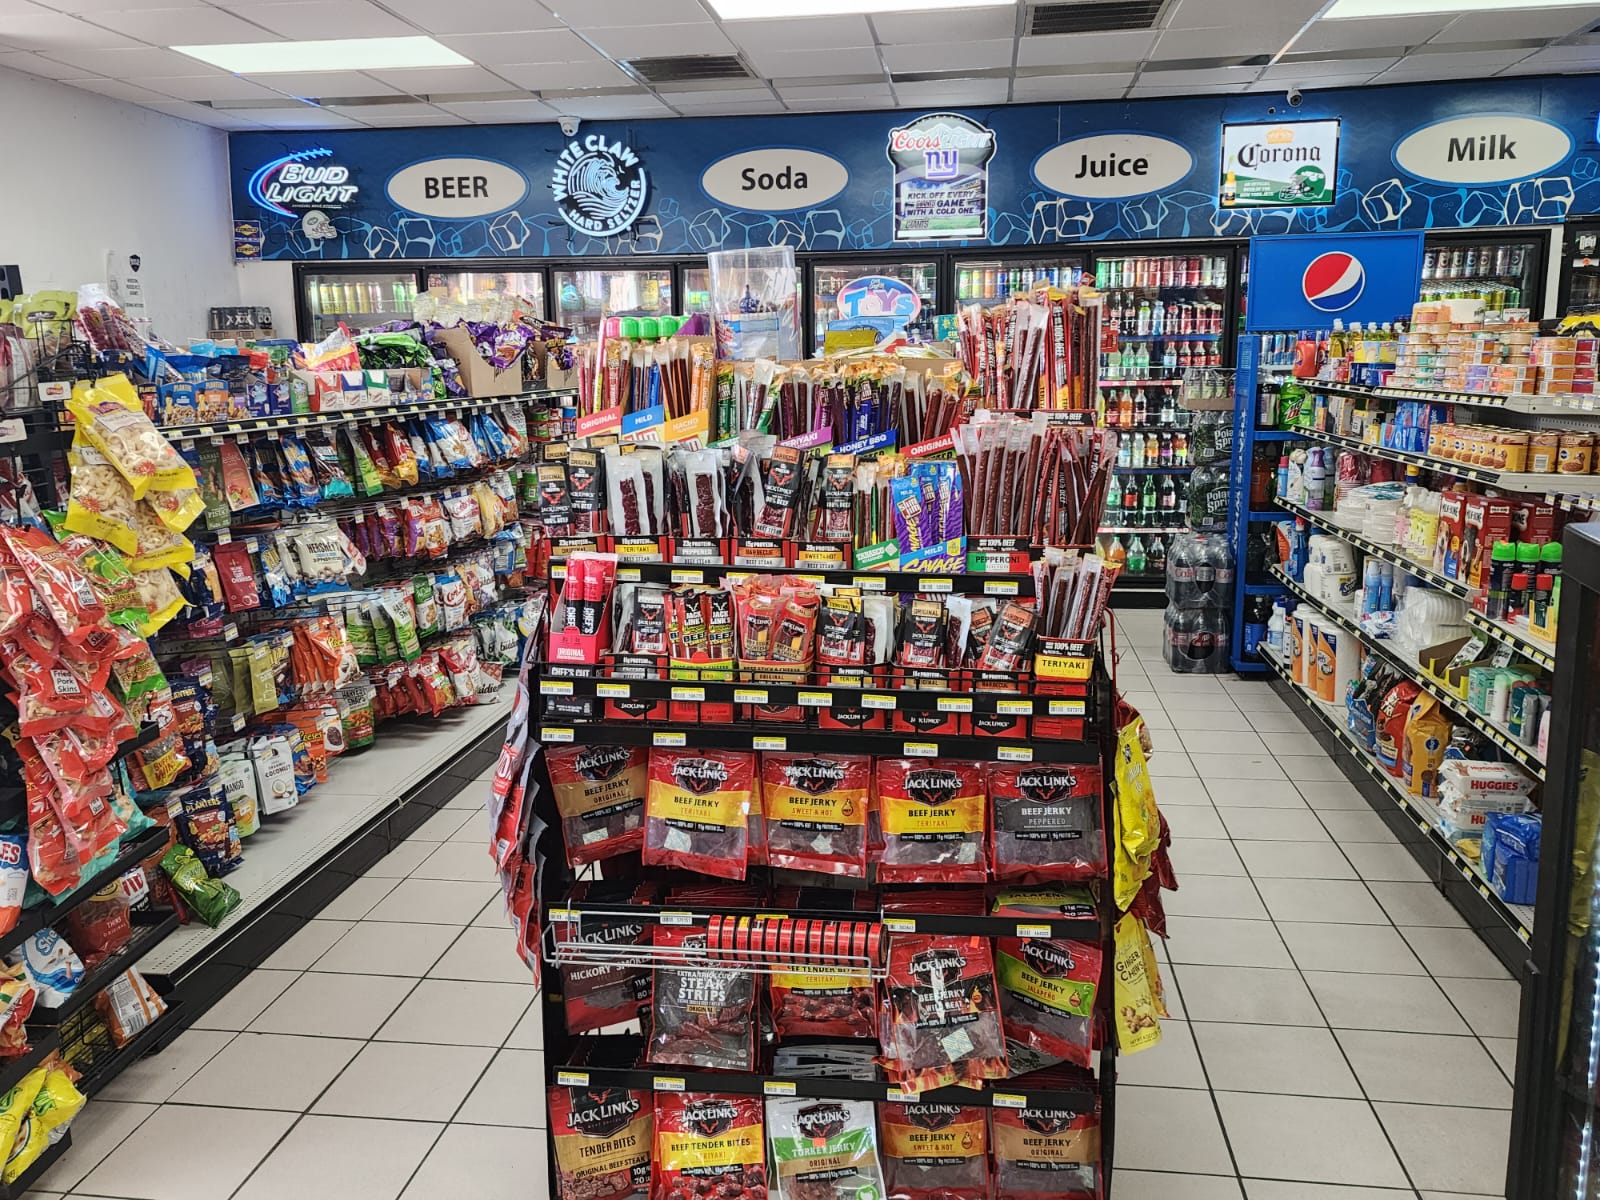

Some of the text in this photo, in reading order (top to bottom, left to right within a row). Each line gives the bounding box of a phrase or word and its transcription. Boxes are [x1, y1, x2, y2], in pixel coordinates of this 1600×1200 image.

[895, 130, 941, 150] Coors
[1447, 134, 1517, 163] Milk
[1237, 143, 1320, 171] Corona
[552, 134, 640, 201] WHITE CLAW
[1075, 153, 1149, 178] Juice
[279, 163, 349, 184] BUD
[741, 165, 809, 191] Soda
[265, 182, 360, 203] LIGHT
[424, 176, 489, 199] BEER
[908, 192, 927, 200] KICK
[937, 199, 966, 207] GAME
[569, 180, 640, 231] HARD SELTZER
[907, 208, 927, 216] WITH
[936, 207, 956, 215] COLD
[581, 414, 618, 430] ORIGINAL
[635, 414, 653, 425] MILD
[840, 440, 868, 453] HONEY
[870, 434, 887, 445] BBQ
[910, 437, 952, 455] ORIGINAL
[924, 546, 943, 555] MILD
[975, 556, 1020, 564] PEPPERONI
[914, 608, 939, 616] ORIGINAL
[683, 632, 706, 643] BEEF
[709, 631, 732, 641] BEEF
[557, 647, 585, 656] ORIGINAL
[1069, 643, 1085, 651] BEEF
[1042, 659, 1086, 670] TERIYAKI
[575, 668, 591, 678] CUT
[57, 685, 79, 693] Skins
[574, 746, 631, 773] JACK LINK'S
[264, 764, 291, 779] COCONUT
[671, 765, 728, 782] JACK LINK'S
[785, 764, 845, 779] JACK LINK'S
[225, 779, 245, 794] MANGO
[584, 778, 630, 796] BEEF JERKY
[903, 777, 963, 790] JACK LINK'S
[1015, 775, 1077, 789] JACK LINK'S
[1470, 779, 1519, 791] HUGGIES
[593, 790, 625, 804] ORIGINAL
[674, 796, 720, 808] BEEF JERKY
[789, 795, 837, 807] BEEF JERKY
[185, 797, 221, 815] PLANTERS
[680, 807, 711, 817] TERIYAKI
[908, 808, 956, 818] BEEF JERKY
[1021, 806, 1072, 816] BEEF JERKY
[916, 819, 948, 827] TERIYAKI
[106, 916, 122, 929] THINS
[604, 924, 643, 939] LINK'S
[1019, 943, 1076, 970] JACK LINK'S
[1115, 951, 1141, 972] GINGER
[569, 956, 650, 981] HICKORY SMOKE
[909, 956, 967, 976] JACK LINK'S
[1120, 961, 1145, 981] CHEWS
[680, 977, 725, 990] STEAK
[1021, 970, 1066, 995] BEEF JERKY
[678, 989, 726, 1002] STRIPS
[918, 988, 966, 1003] BEEF JERKY
[567, 1109, 601, 1128] JACK
[600, 1099, 641, 1118] LINK'S
[681, 1107, 738, 1121] JACK LINK'S
[903, 1103, 961, 1116] JACK LINK'S
[1018, 1108, 1077, 1120] JACK LINK'S
[671, 1137, 751, 1152] BEEF TENDER BITES
[909, 1133, 957, 1142] BEEF JERKY
[1023, 1138, 1072, 1147] BEEF JERKY
[579, 1135, 637, 1159] TENDER BITES
[791, 1142, 856, 1158] TURKEY JERKY
[575, 1155, 647, 1179] ORIGINAL BEEF STEAK
[809, 1157, 841, 1168] ORIGINAL
[632, 1167, 645, 1176] 10g
[634, 1176, 645, 1185] 70
